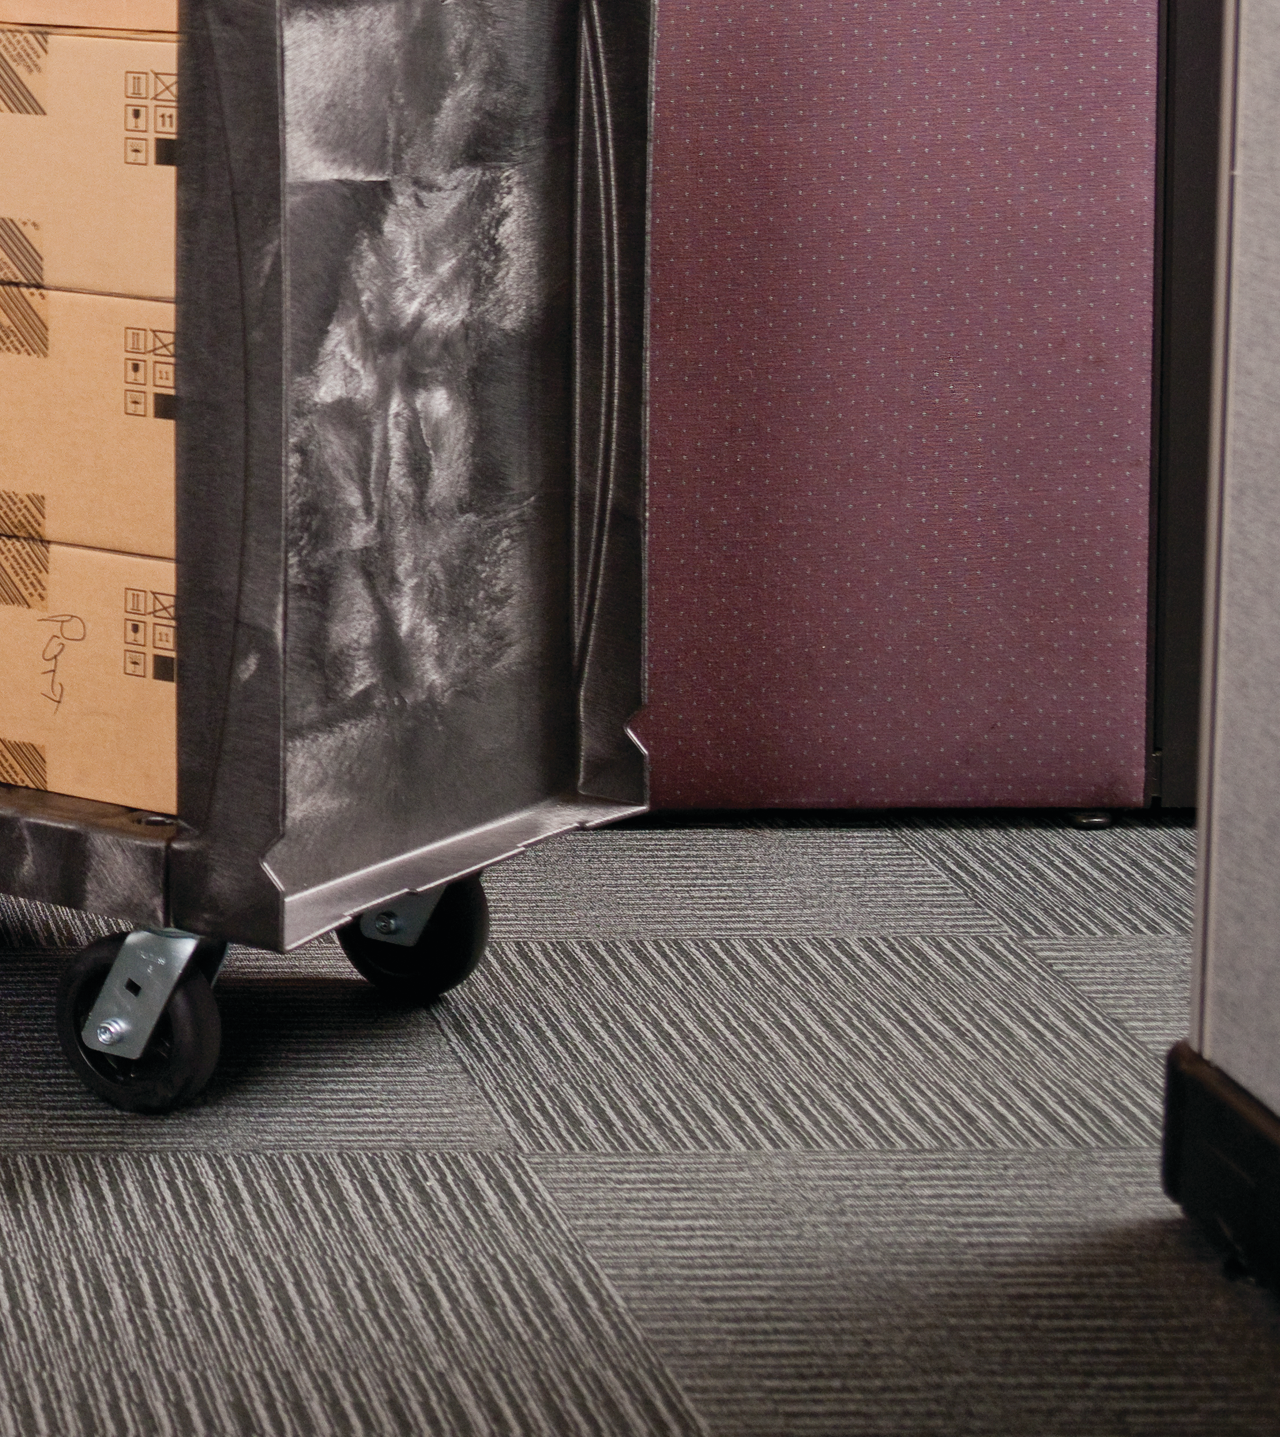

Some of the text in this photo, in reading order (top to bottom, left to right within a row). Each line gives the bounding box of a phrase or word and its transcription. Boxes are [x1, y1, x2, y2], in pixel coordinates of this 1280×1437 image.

[159, 113, 174, 127] 11
[159, 369, 170, 380] 11
[158, 631, 170, 643] 11
